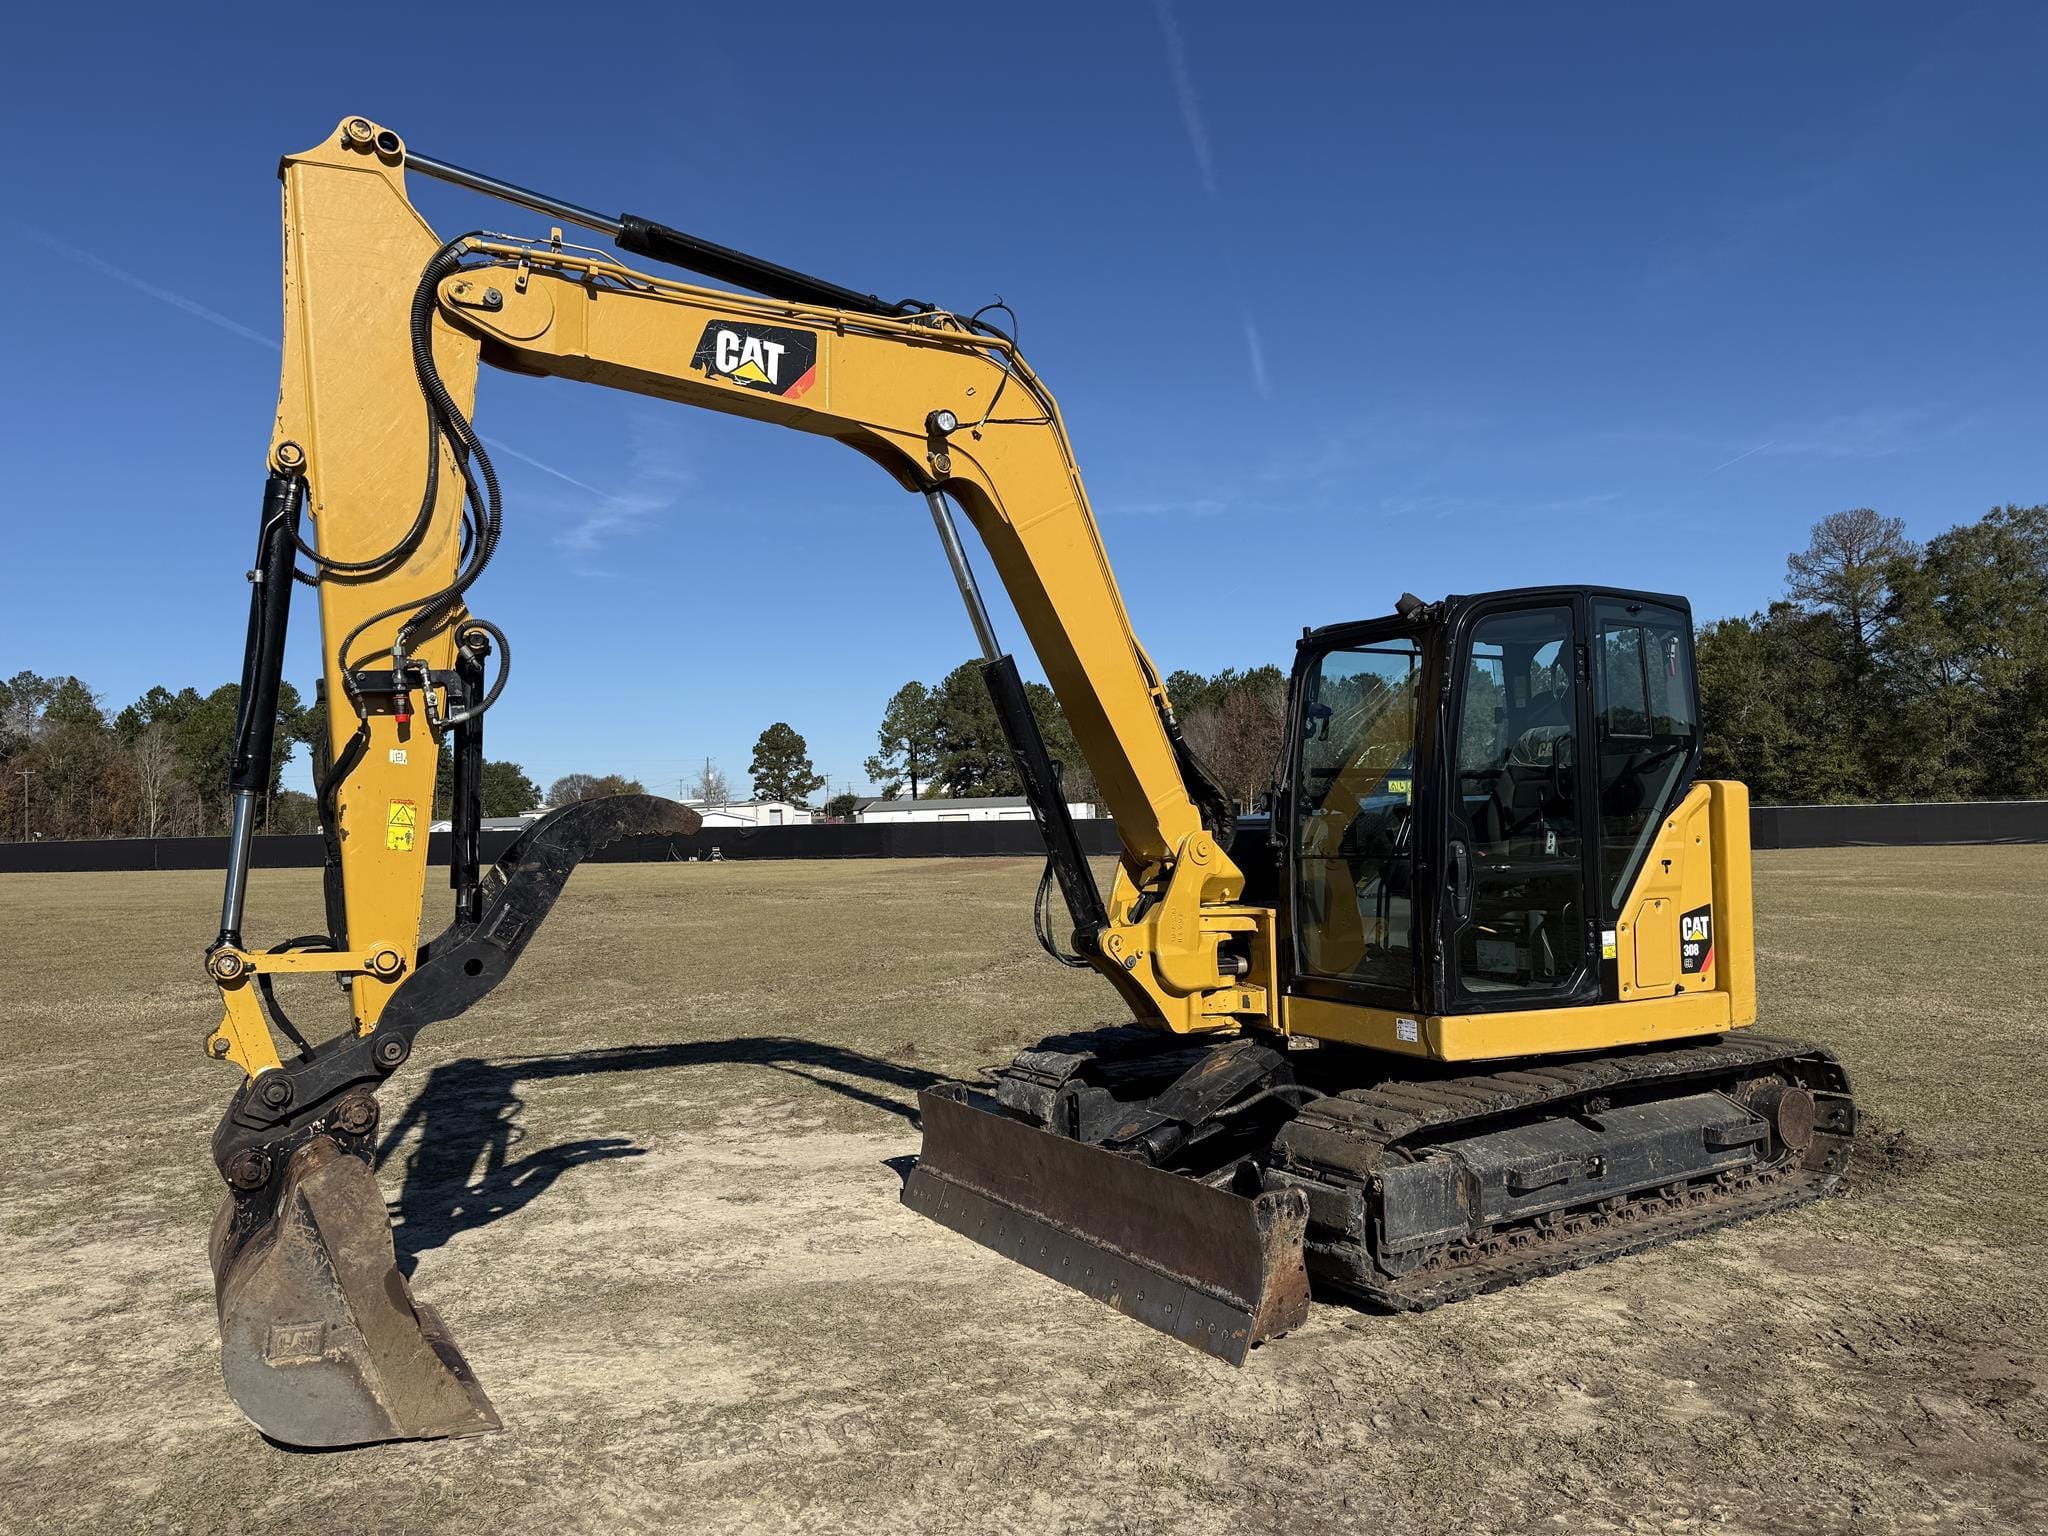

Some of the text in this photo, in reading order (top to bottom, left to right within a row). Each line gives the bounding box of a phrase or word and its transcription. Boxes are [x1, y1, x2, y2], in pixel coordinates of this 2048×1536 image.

[715, 329, 785, 386] CAT
[1682, 916, 1709, 941] CAT
[1683, 943, 1700, 957] 308
